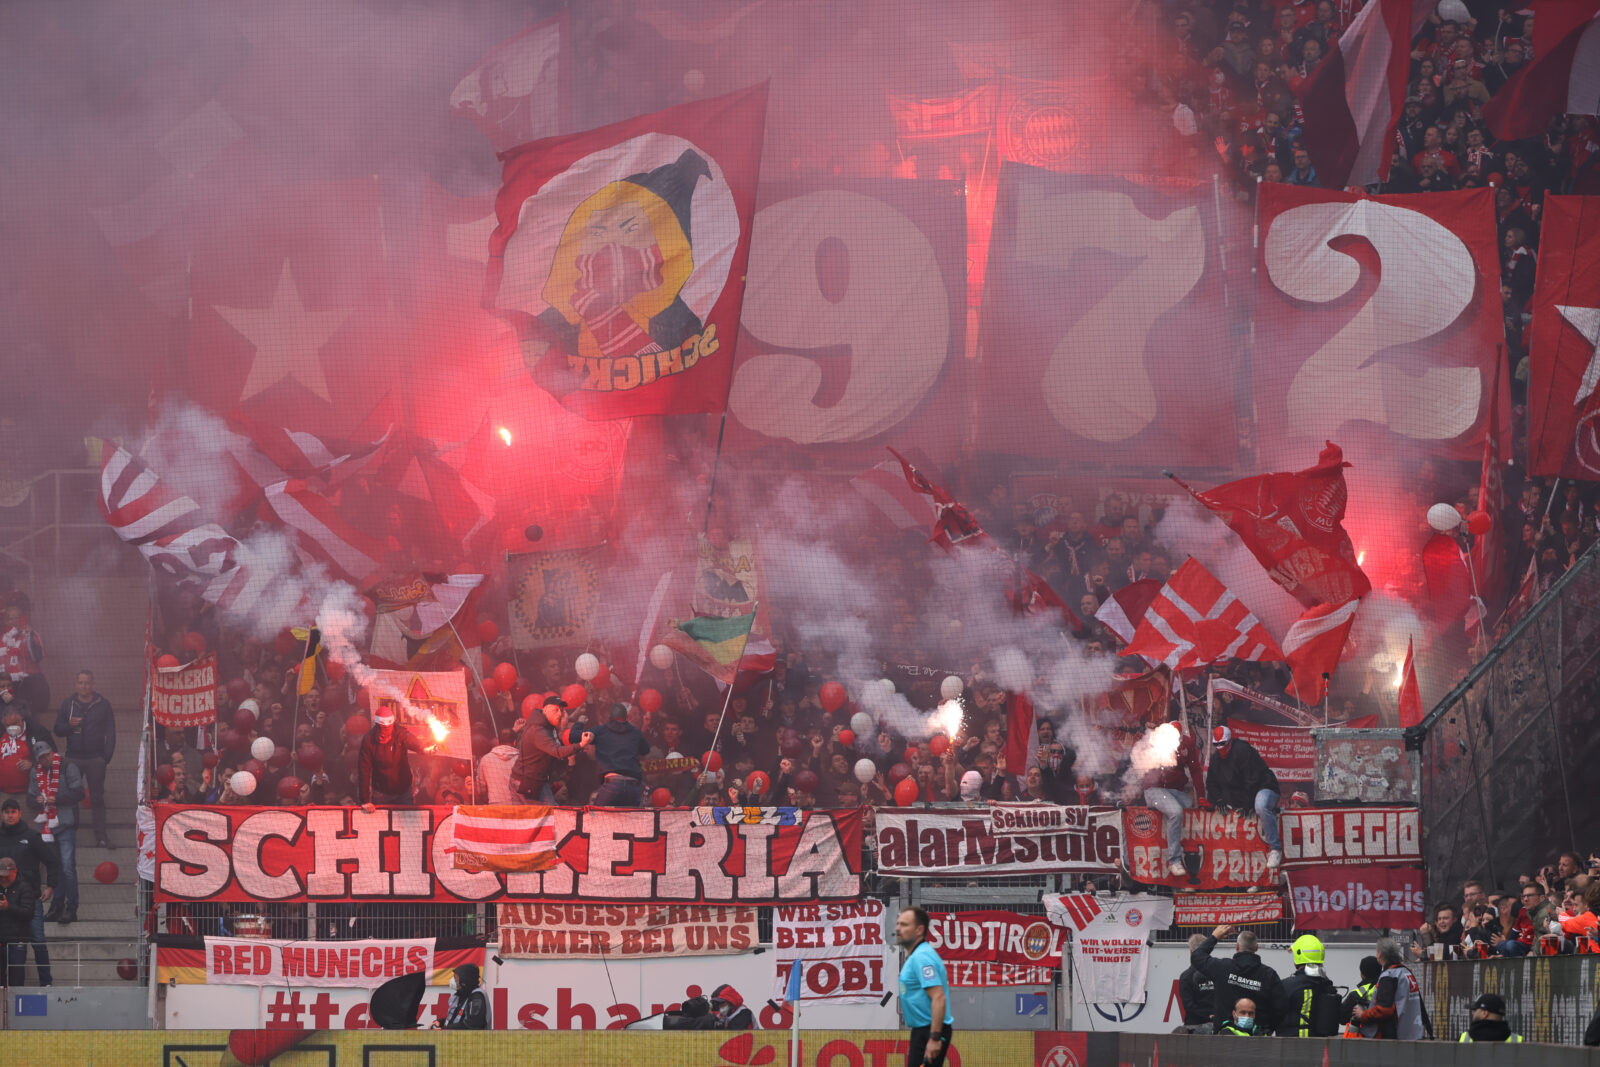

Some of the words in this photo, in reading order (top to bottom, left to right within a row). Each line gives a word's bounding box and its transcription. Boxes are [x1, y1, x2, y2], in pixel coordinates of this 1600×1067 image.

[992, 808, 1062, 829] Sektion
[1065, 807, 1088, 826] SV
[1281, 813, 1421, 859] COLEGIO
[776, 904, 822, 922] WIR
[826, 899, 883, 921] SIND
[1293, 883, 1425, 914] Rhoibazis
[1177, 911, 1216, 923] IMMER
[1218, 908, 1280, 923] ANWESEND
[501, 926, 611, 955] IMMER
[616, 926, 676, 952] BEI
[684, 924, 752, 951] UNS
[776, 925, 826, 949] BEI
[832, 922, 883, 947] DIR
[1080, 938, 1099, 946] WIR
[1101, 938, 1141, 946] WOLLEN
[213, 944, 272, 976] RED
[942, 959, 998, 986] TZTE
[1229, 973, 1238, 981] FC
[1237, 975, 1262, 988] BAYERN
